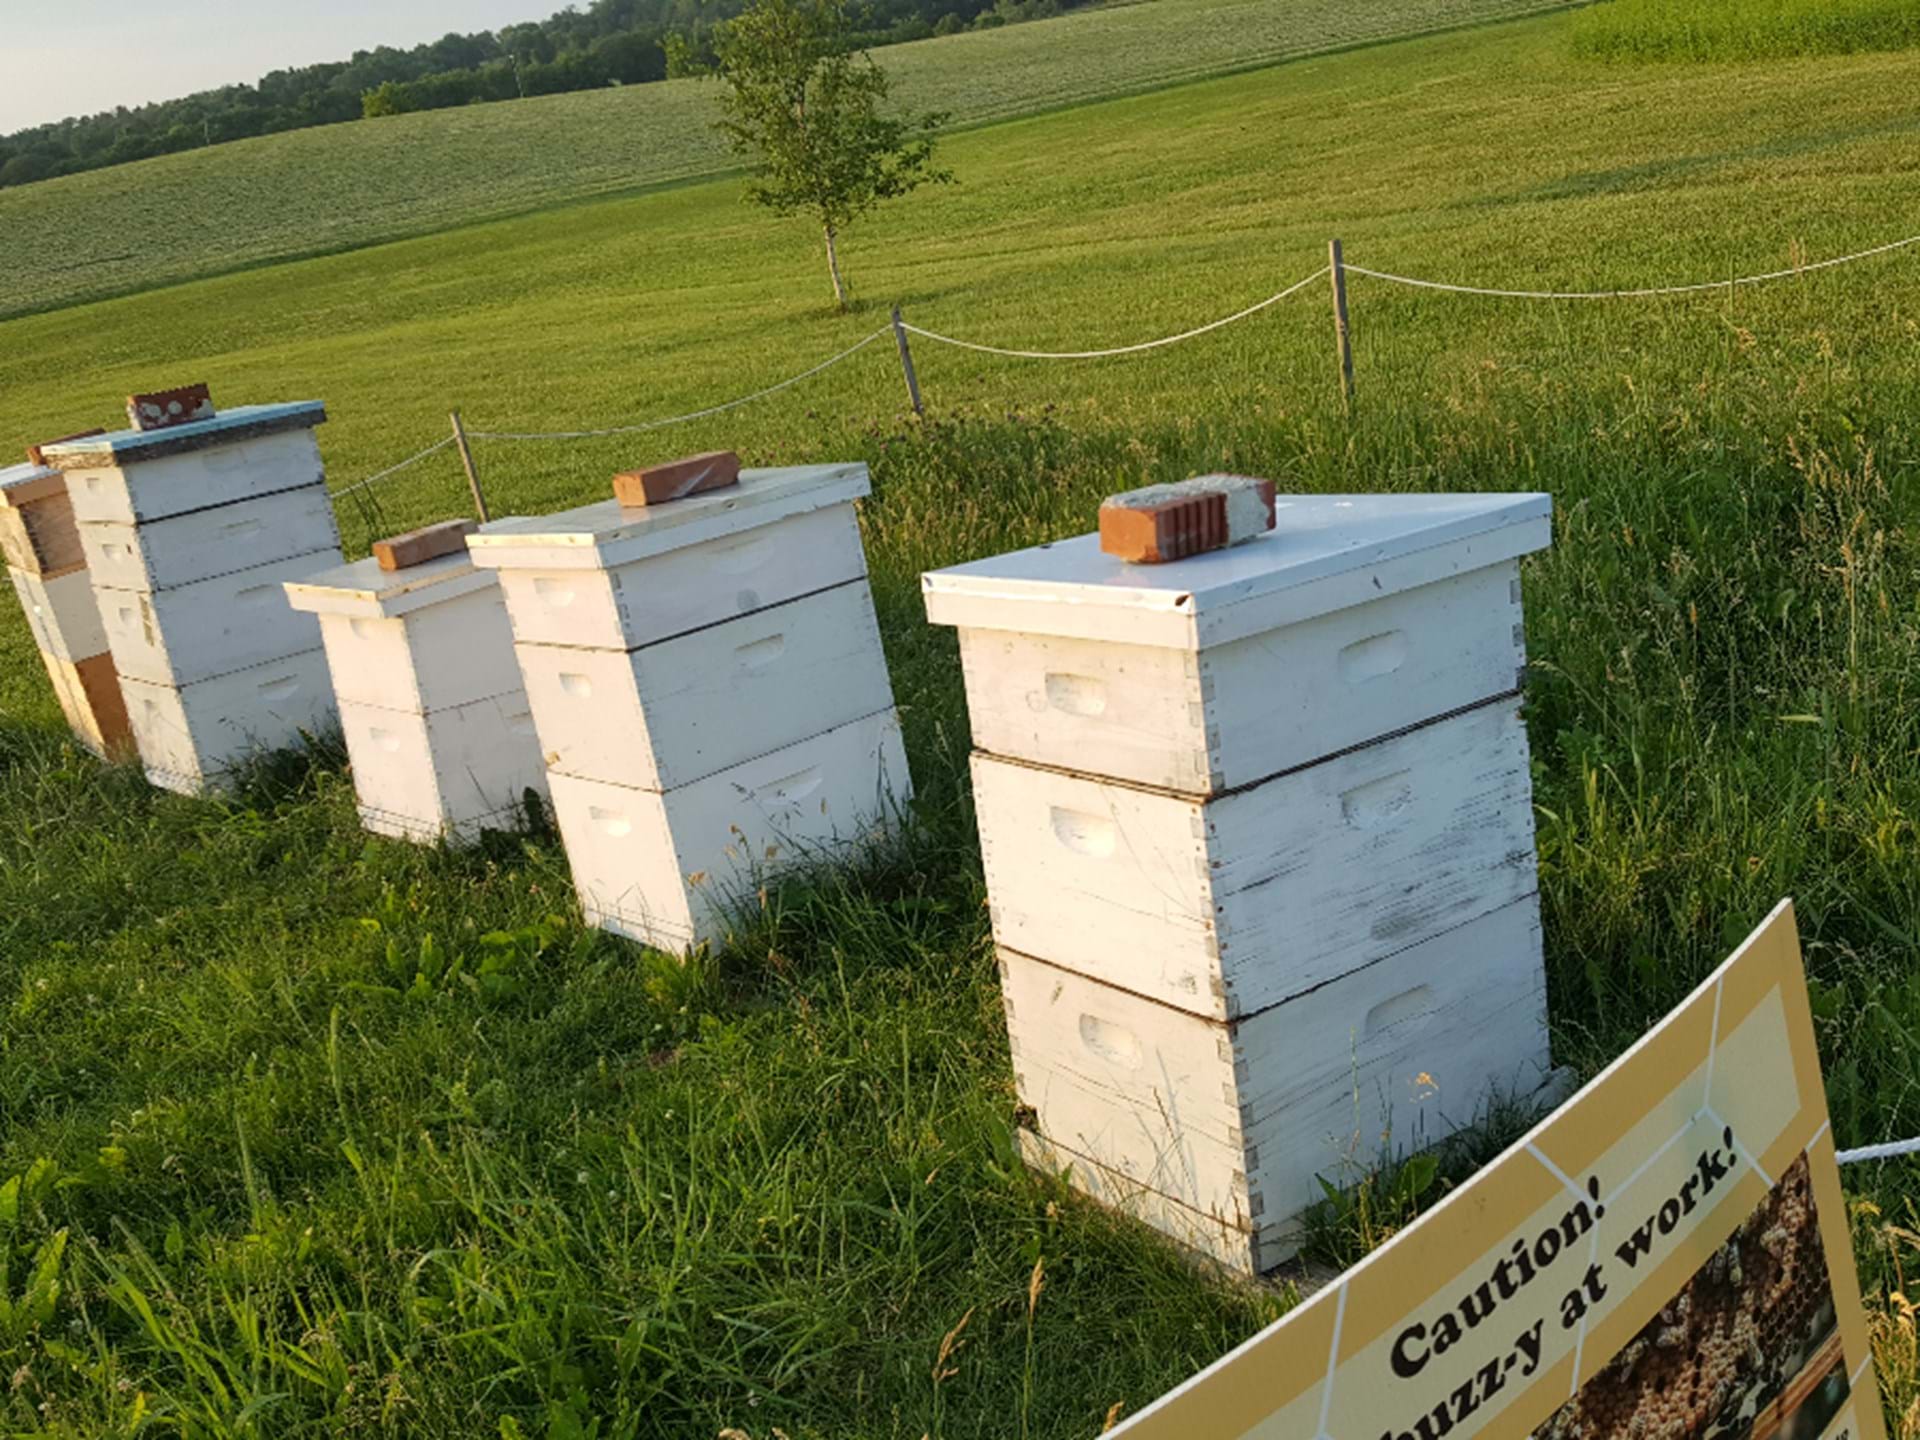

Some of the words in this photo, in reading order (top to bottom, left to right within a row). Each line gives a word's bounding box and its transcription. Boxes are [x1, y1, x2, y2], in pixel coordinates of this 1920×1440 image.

[1379, 1317, 1544, 1440] uzz-y
[1560, 1263, 1608, 1330] at
[1614, 1125, 1737, 1269] work!
[1390, 1175, 1605, 1379] Caution!
